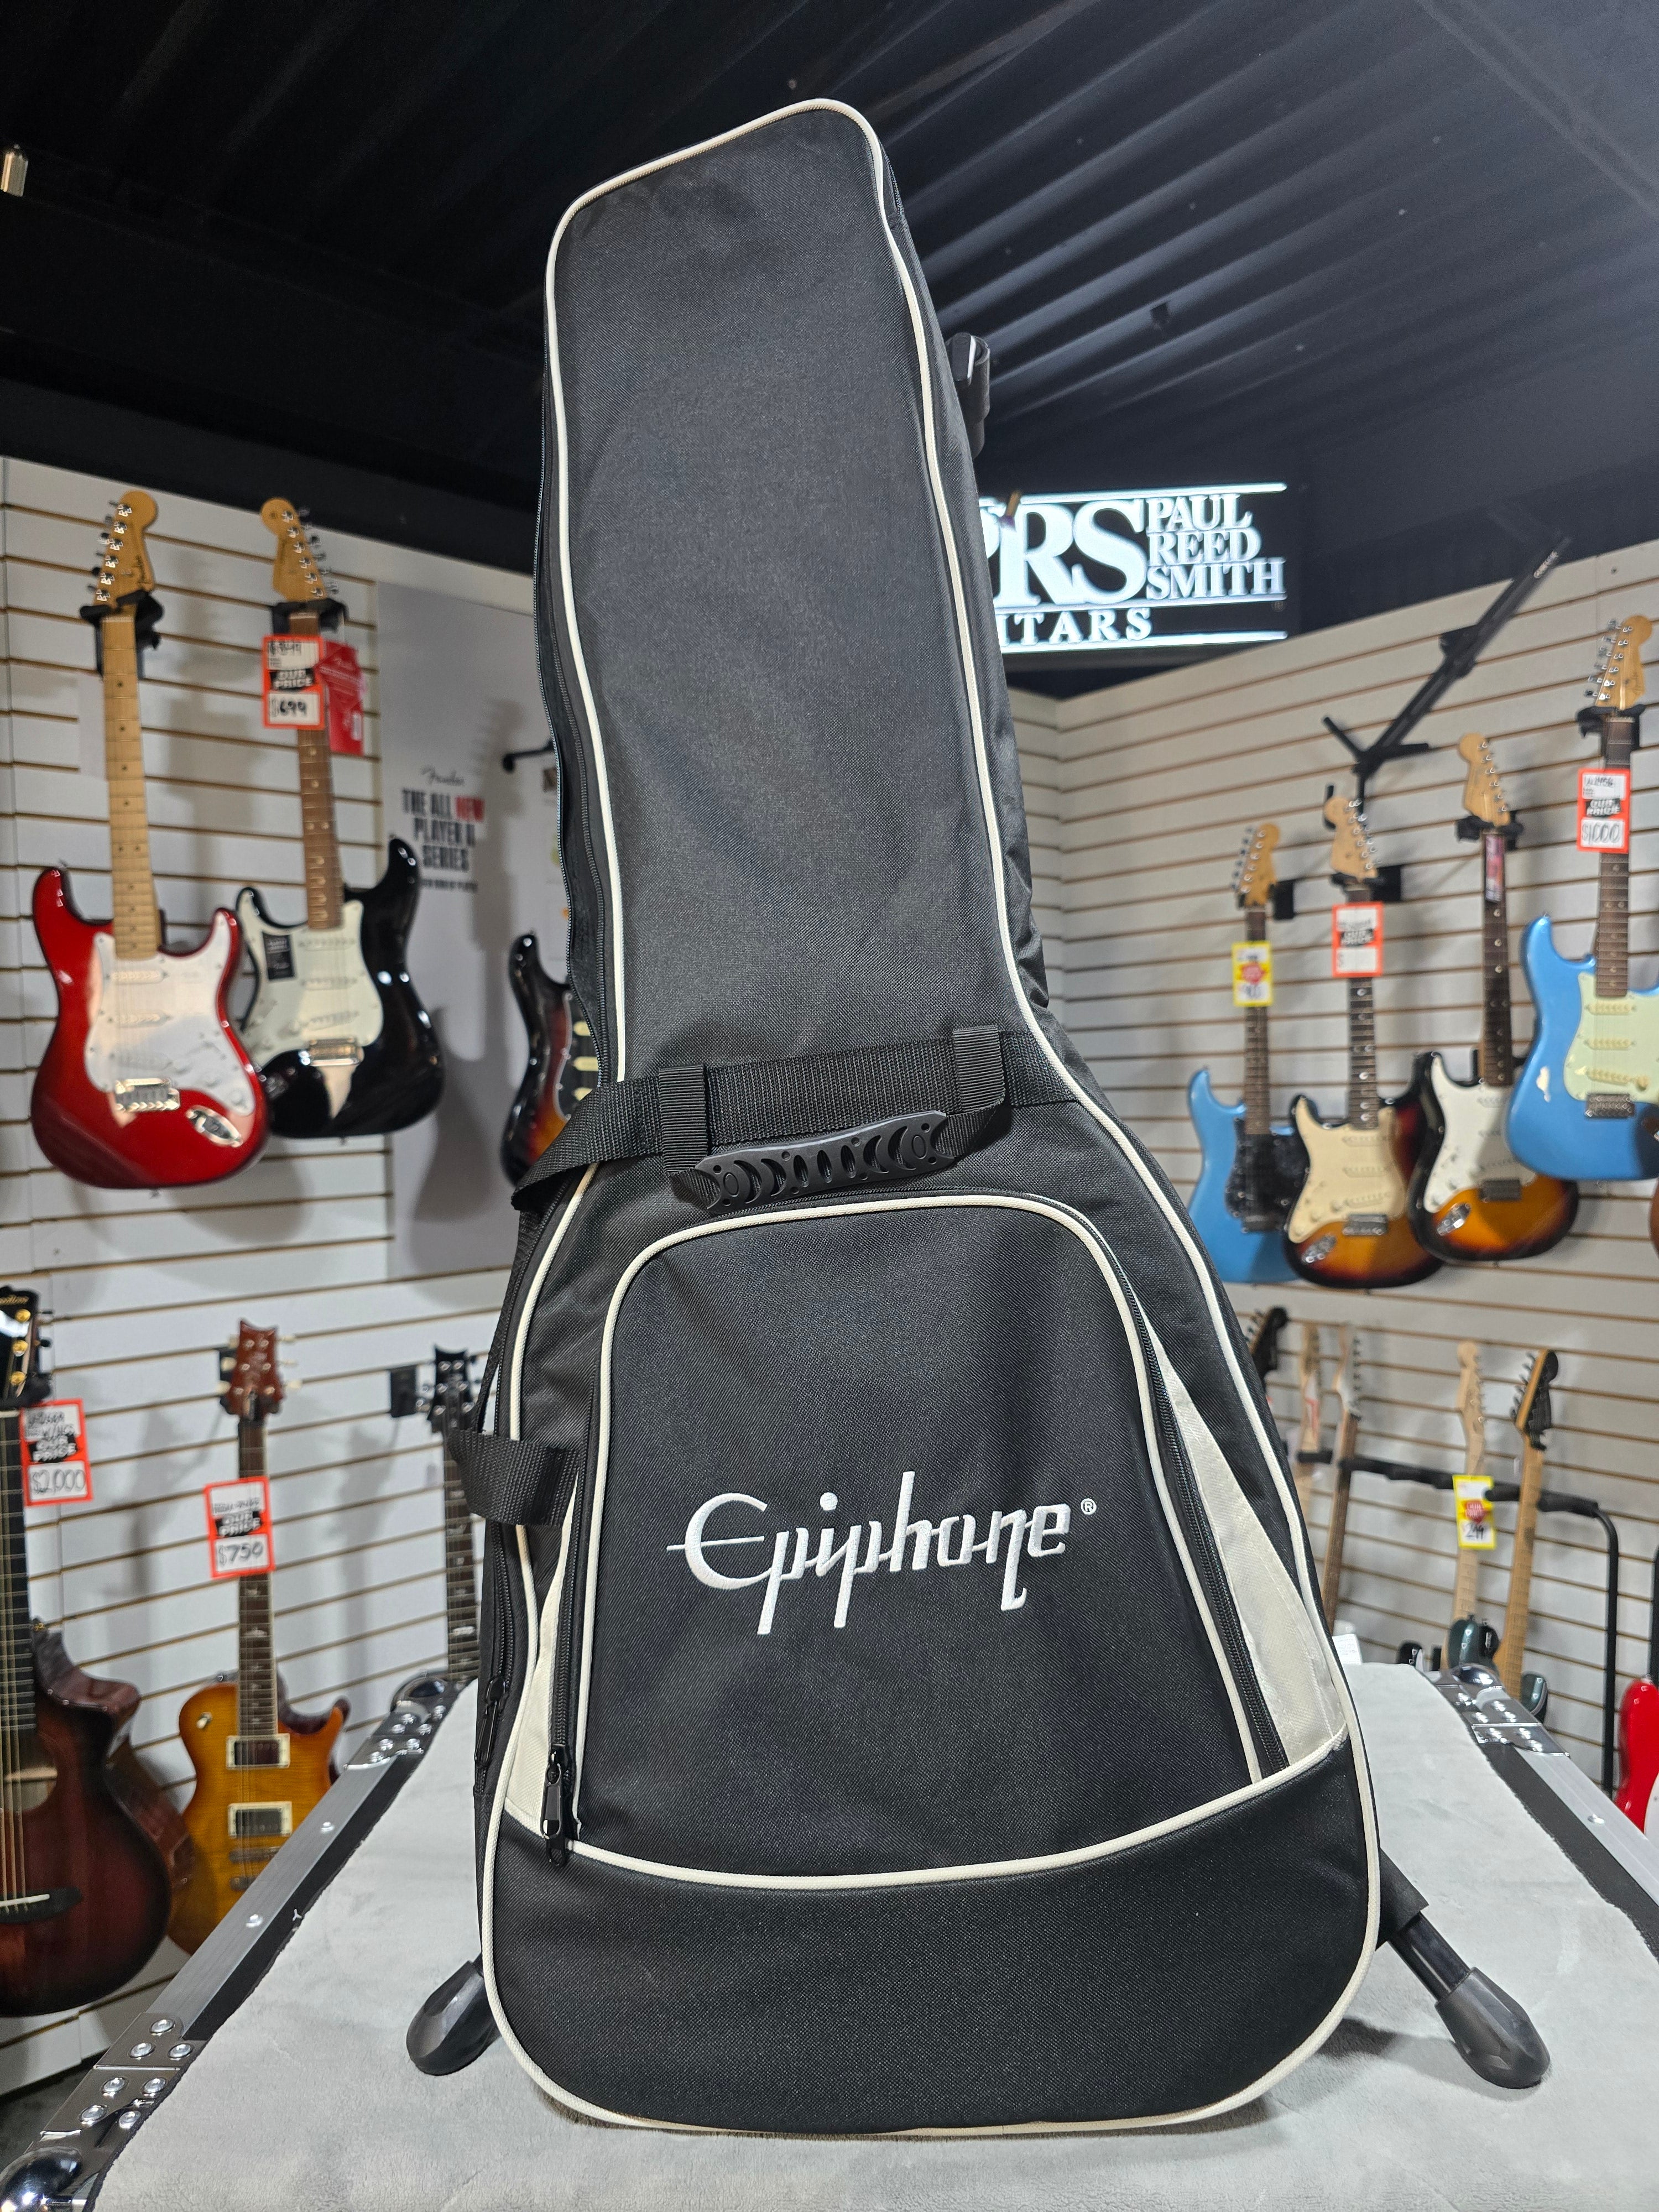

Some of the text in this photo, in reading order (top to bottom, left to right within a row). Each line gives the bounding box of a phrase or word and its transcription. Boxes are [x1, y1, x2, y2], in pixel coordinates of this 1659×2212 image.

[1145, 493, 1253, 532] PAUL
[1146, 526, 1262, 567] REED
[1146, 557, 1287, 599] SMITH
[667, 1472, 1070, 1635] Epiphone
